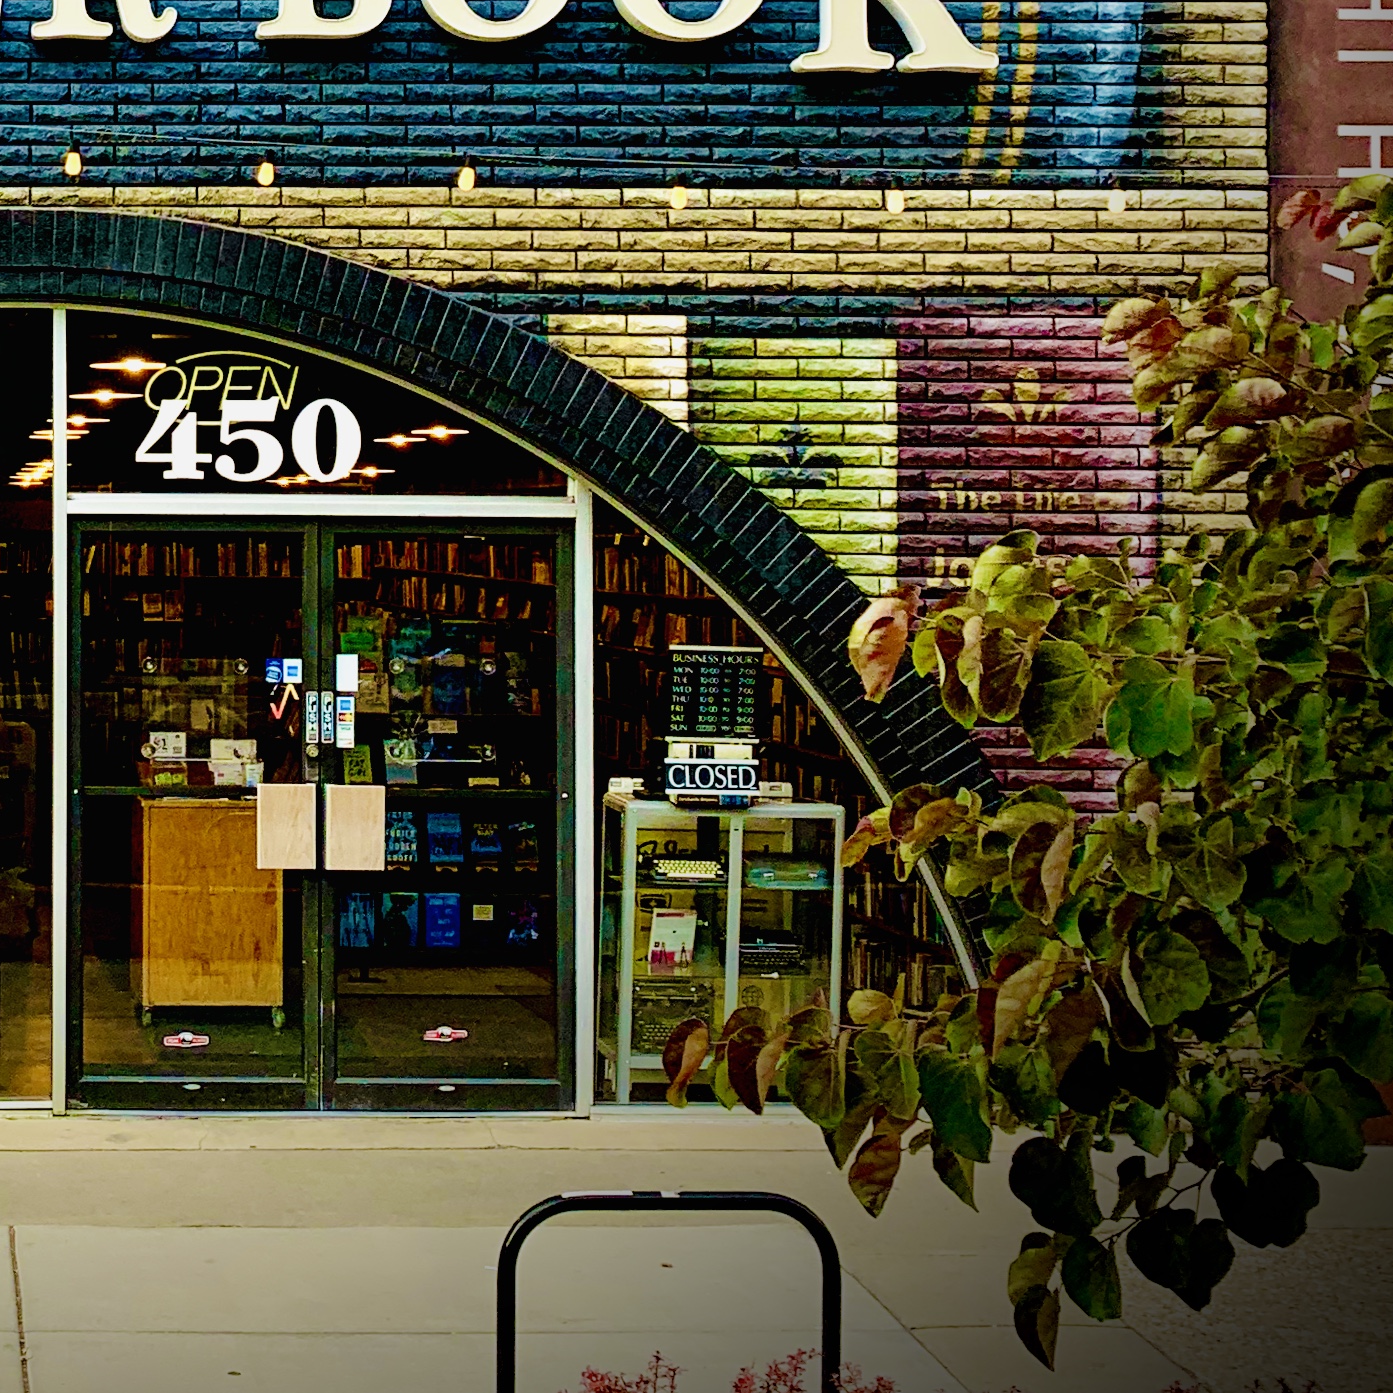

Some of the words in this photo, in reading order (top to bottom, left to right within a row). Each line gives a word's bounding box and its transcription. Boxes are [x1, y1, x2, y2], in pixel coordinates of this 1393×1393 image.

[144, 365, 299, 410] OPEN
[135, 398, 362, 483] 450
[673, 653, 719, 664] BUSINESS
[722, 654, 759, 665] HOURS
[668, 763, 756, 790] CLOSED
